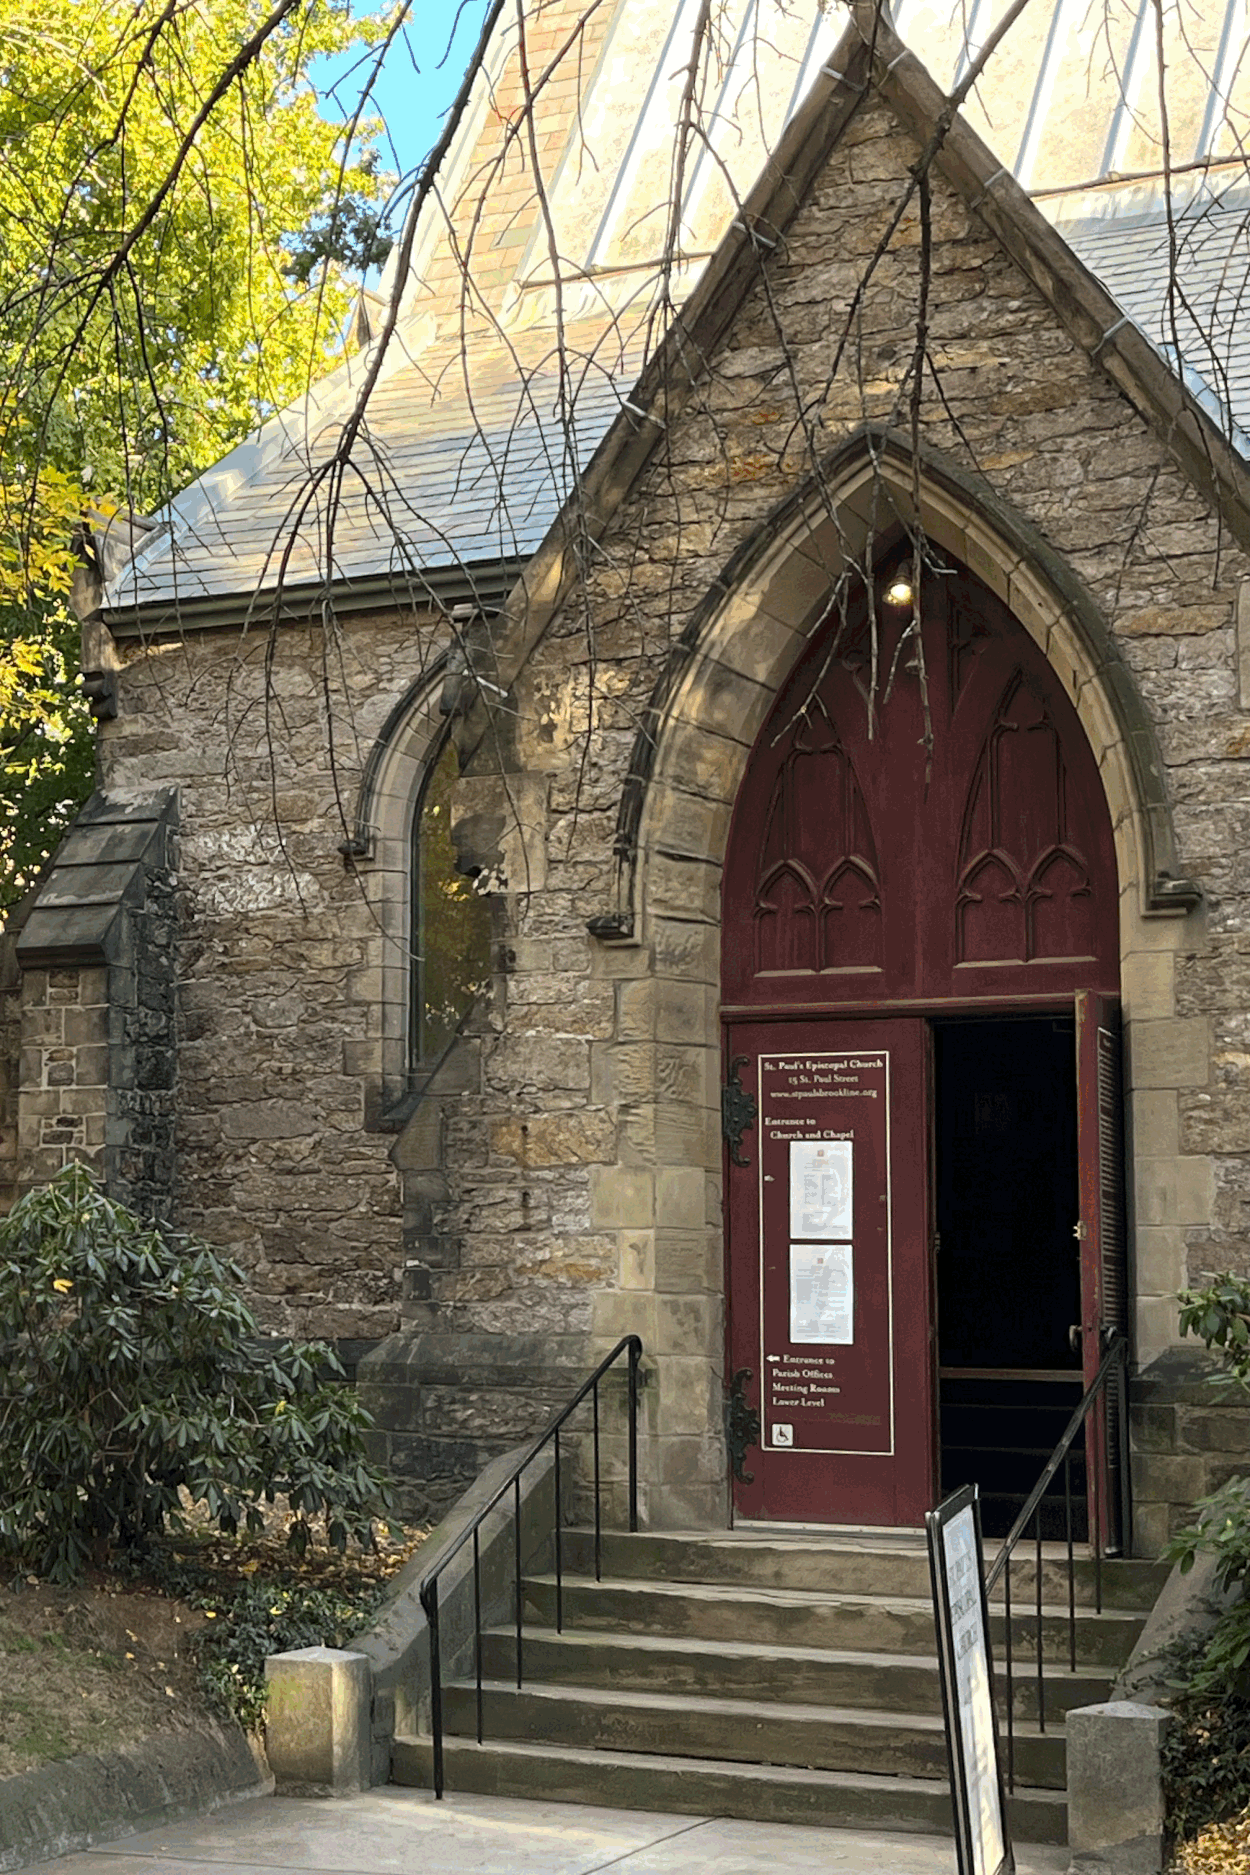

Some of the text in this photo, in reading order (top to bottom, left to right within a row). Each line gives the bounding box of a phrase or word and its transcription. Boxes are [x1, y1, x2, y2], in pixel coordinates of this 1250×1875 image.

[764, 1058, 883, 1071] St. Paul's Episcopal Church
[813, 1074, 832, 1083] Paul
[833, 1073, 859, 1083] Street
[770, 1088, 878, 1100] www.stpaulsbrookline.org
[764, 1117, 816, 1126] Entrance to
[769, 1129, 854, 1141] Church and Chapel
[782, 1355, 835, 1366] Entrance to
[772, 1368, 833, 1380] Parish Offices
[772, 1383, 841, 1394] Meeting Rooms
[772, 1397, 825, 1408] Lower Level
